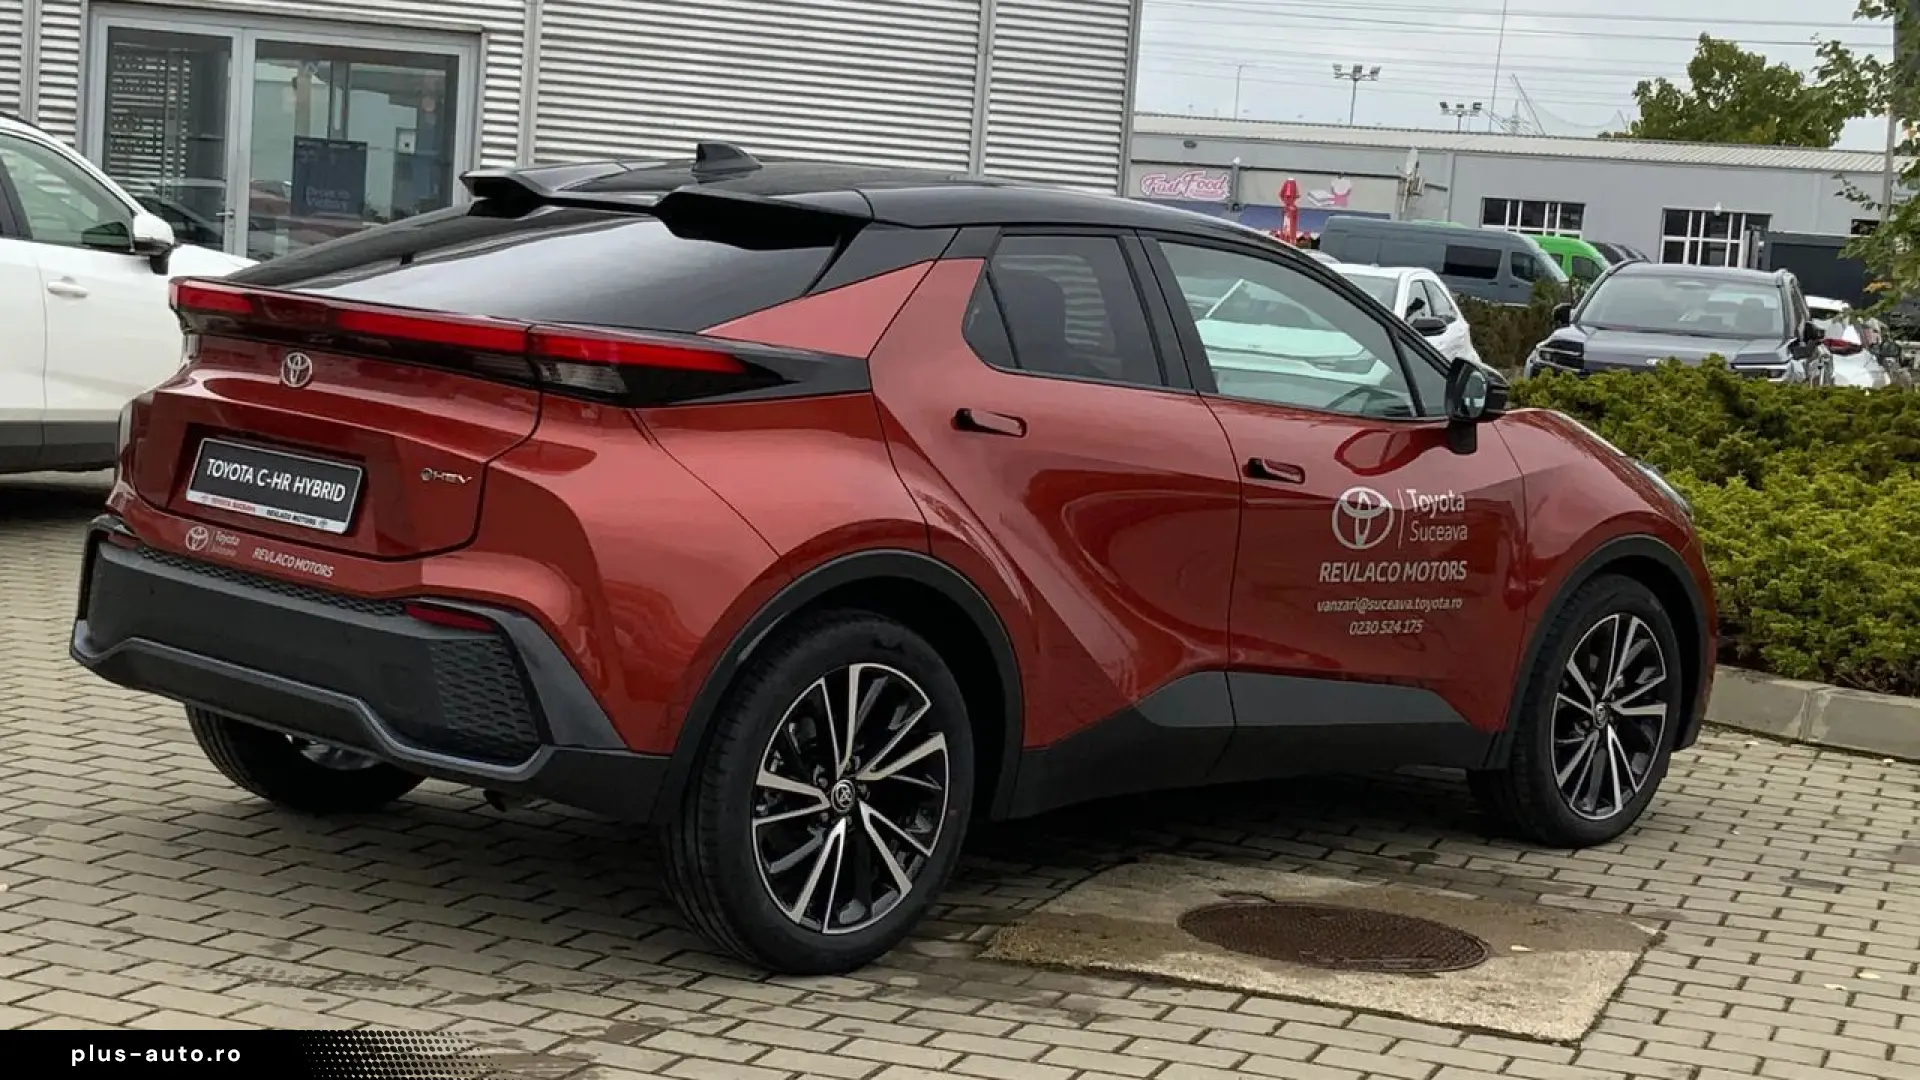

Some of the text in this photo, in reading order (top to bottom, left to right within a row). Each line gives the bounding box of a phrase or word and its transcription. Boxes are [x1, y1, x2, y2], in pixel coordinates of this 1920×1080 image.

[1180, 171, 1229, 198] Food
[206, 458, 346, 502] TOYOTA C-HR HYBRID
[1406, 488, 1466, 519] Toyota
[1409, 520, 1468, 542] Suceava
[252, 546, 295, 568] REVLACO
[293, 557, 335, 579] MOTORS
[1319, 560, 1468, 583] REVLACO MOTORS
[1316, 597, 1463, 615] vanzari@suceava.toyota.ro
[1349, 619, 1424, 636] 0230 524 175
